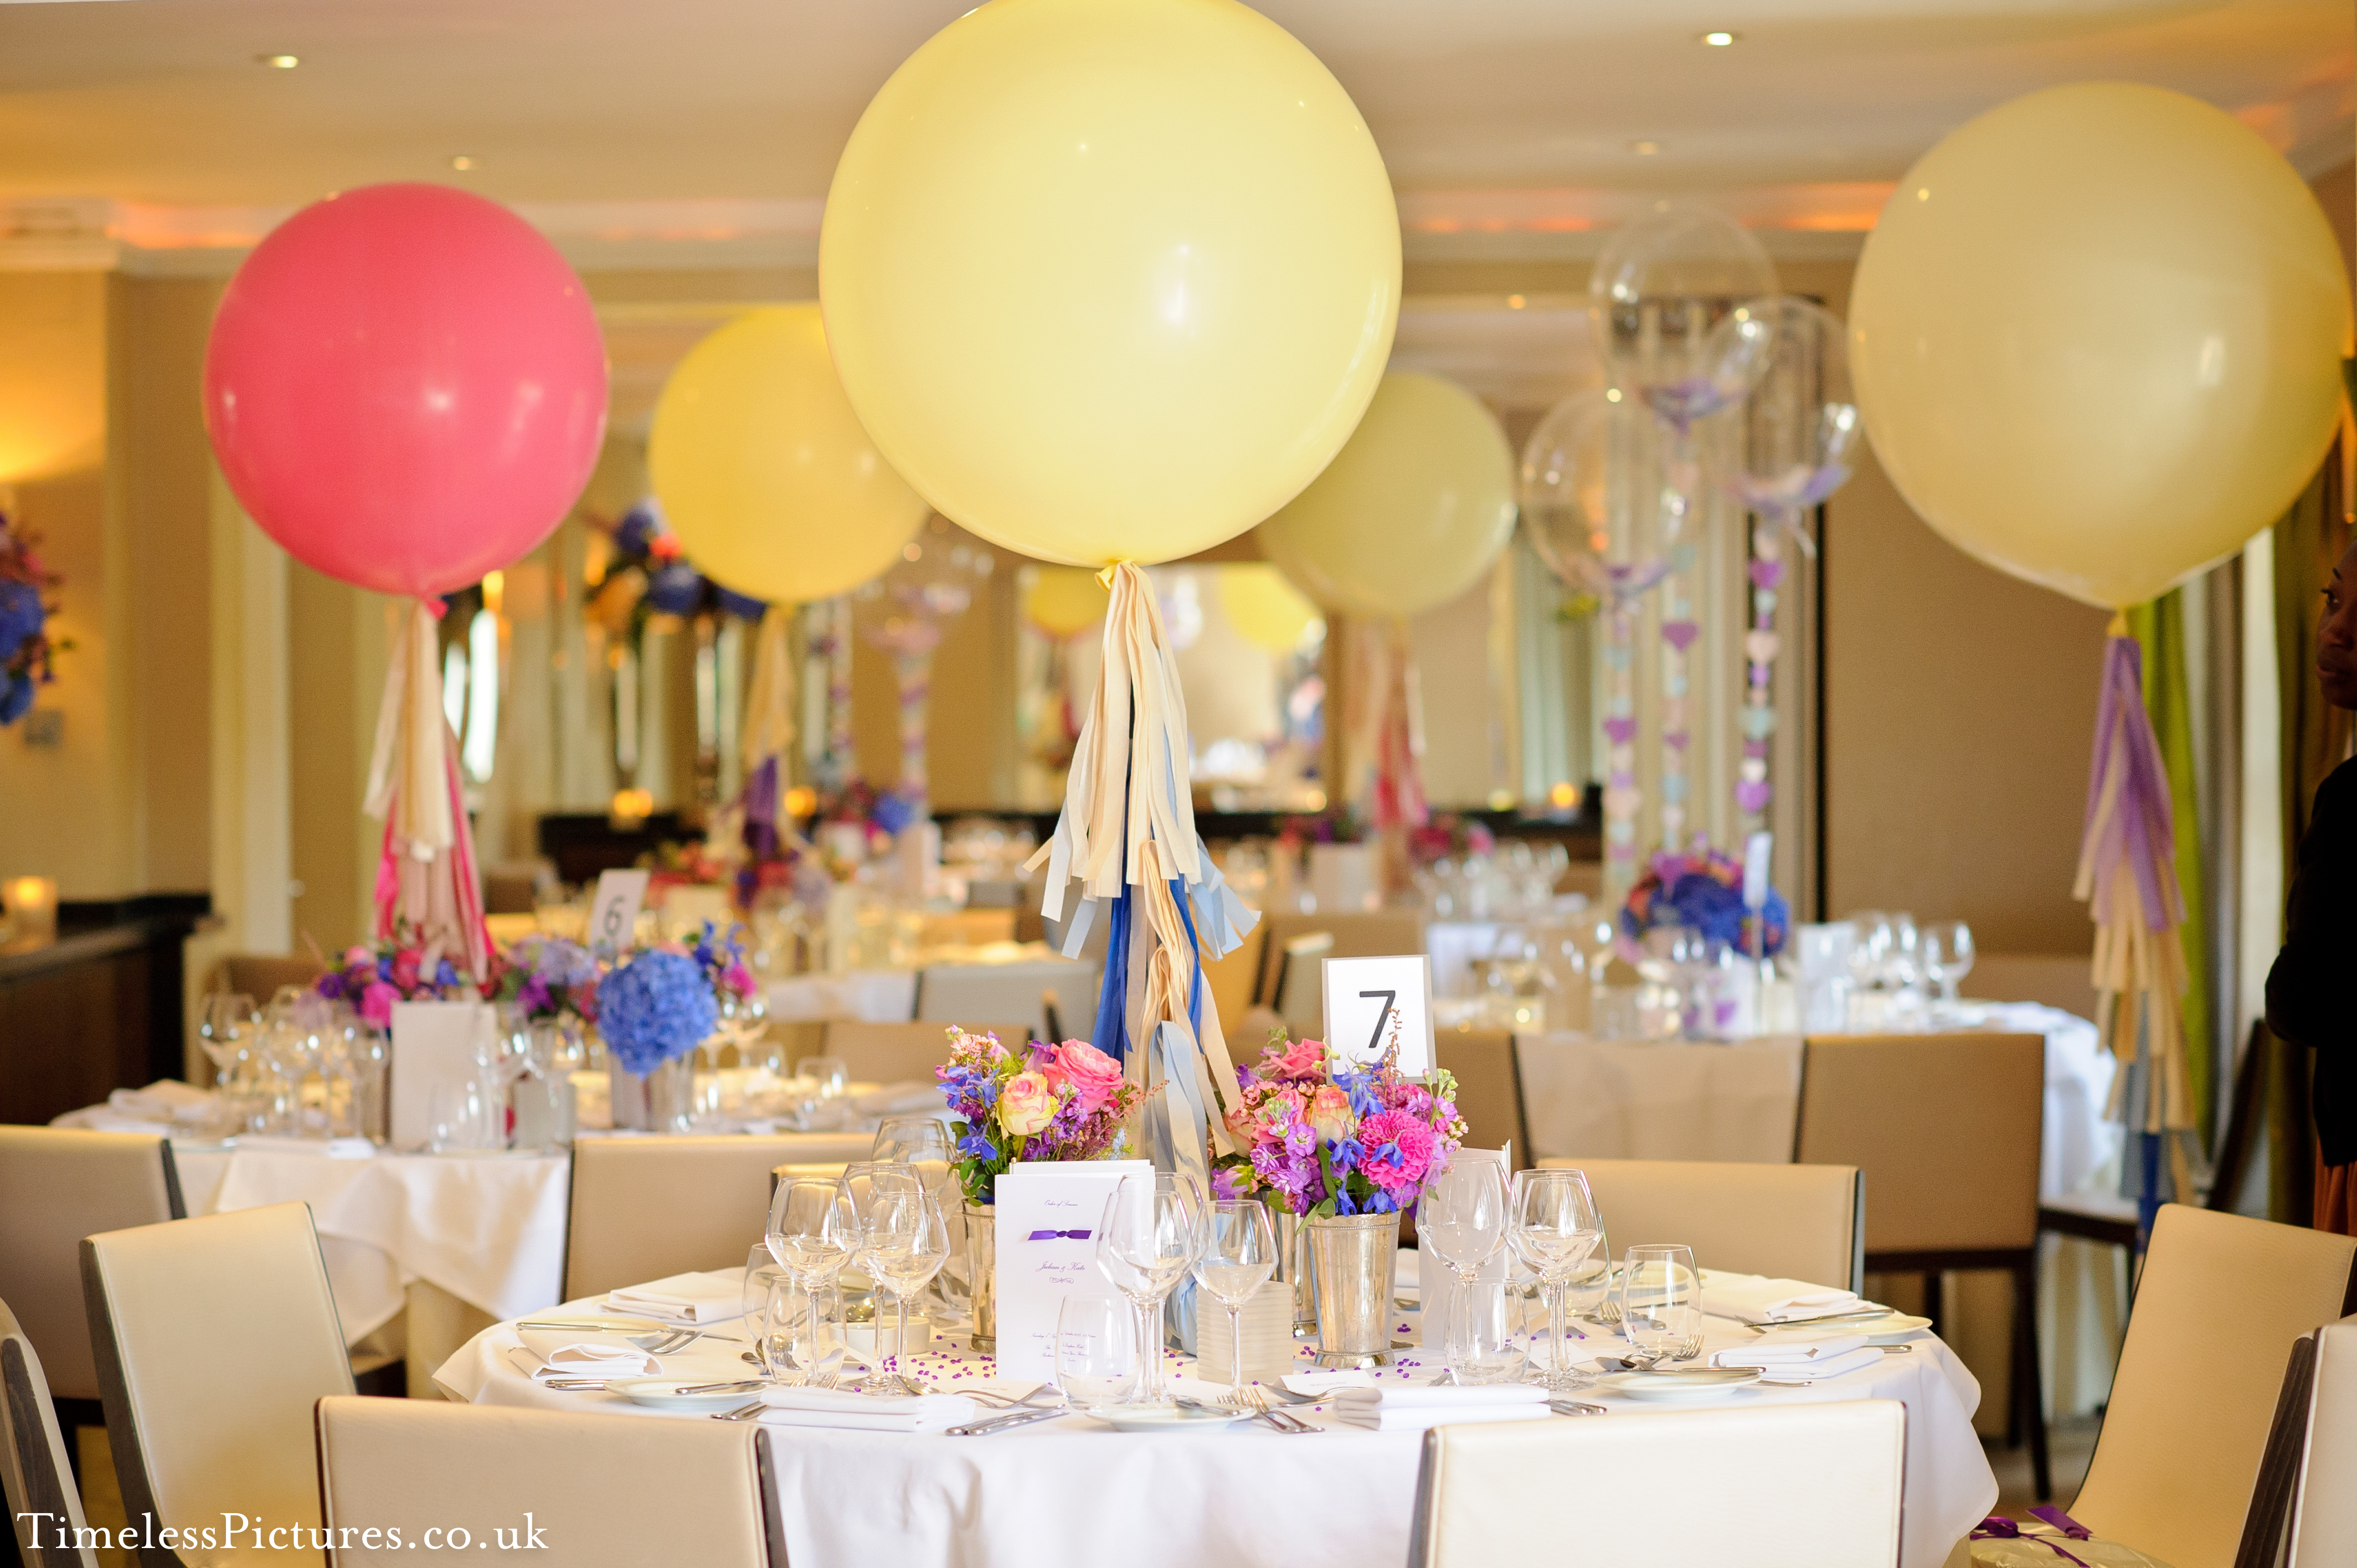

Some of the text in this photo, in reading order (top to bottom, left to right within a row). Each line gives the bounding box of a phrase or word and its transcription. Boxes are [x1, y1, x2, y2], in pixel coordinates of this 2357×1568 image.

[603, 895, 626, 937] 6
[1359, 990, 1396, 1049] 7
[1035, 1261, 1059, 1272] Julian
[1068, 1262, 1085, 1271] Kate
